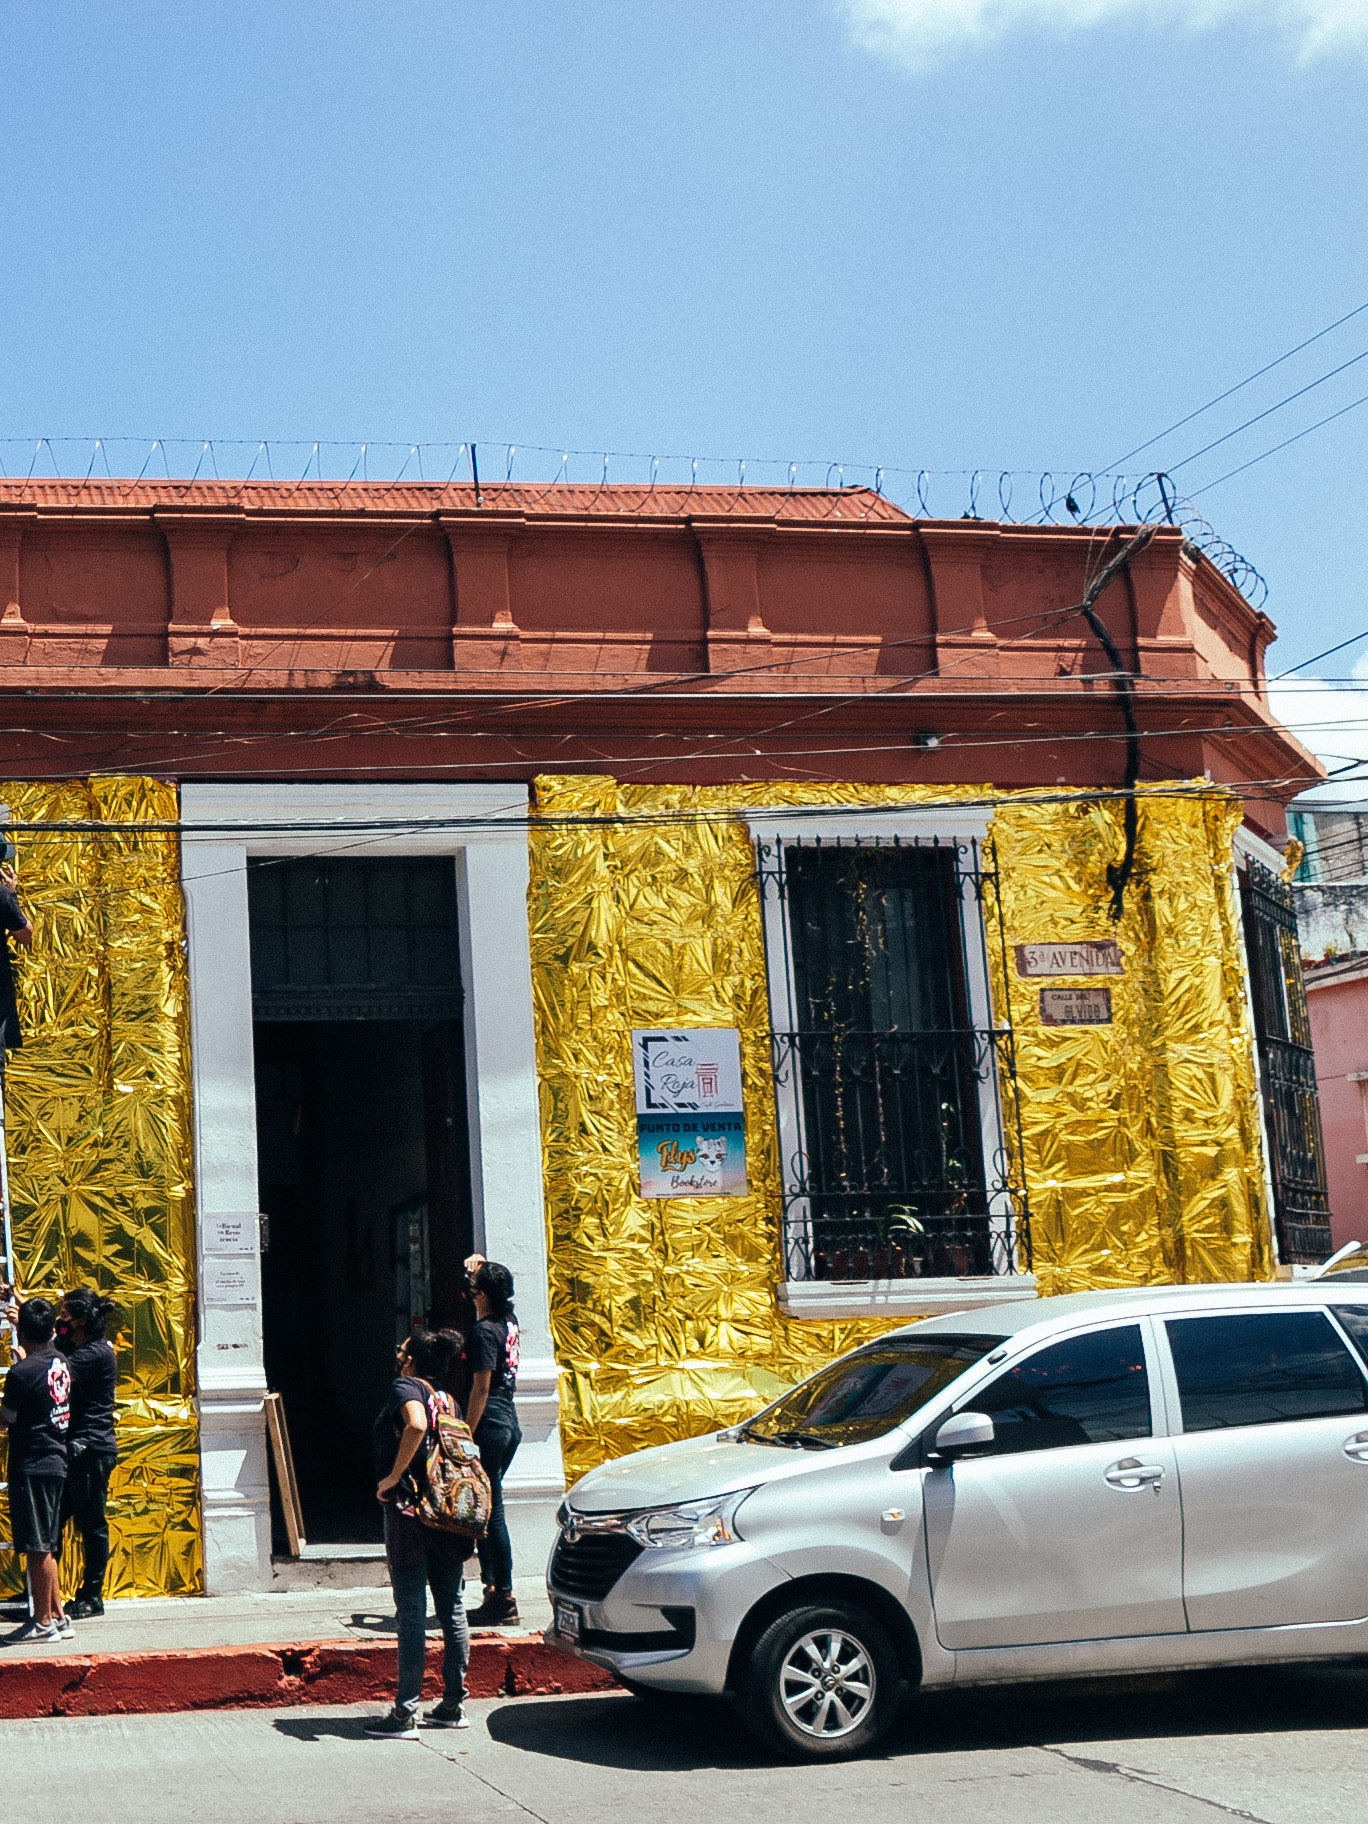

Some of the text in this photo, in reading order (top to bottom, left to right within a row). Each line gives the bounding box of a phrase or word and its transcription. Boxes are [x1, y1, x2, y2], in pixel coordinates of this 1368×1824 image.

[1049, 950, 1113, 968] AVENIDA
[652, 1050, 694, 1068] Casa
[660, 1073, 696, 1098] Roja
[639, 1121, 742, 1134] PUNTO DE VENTA
